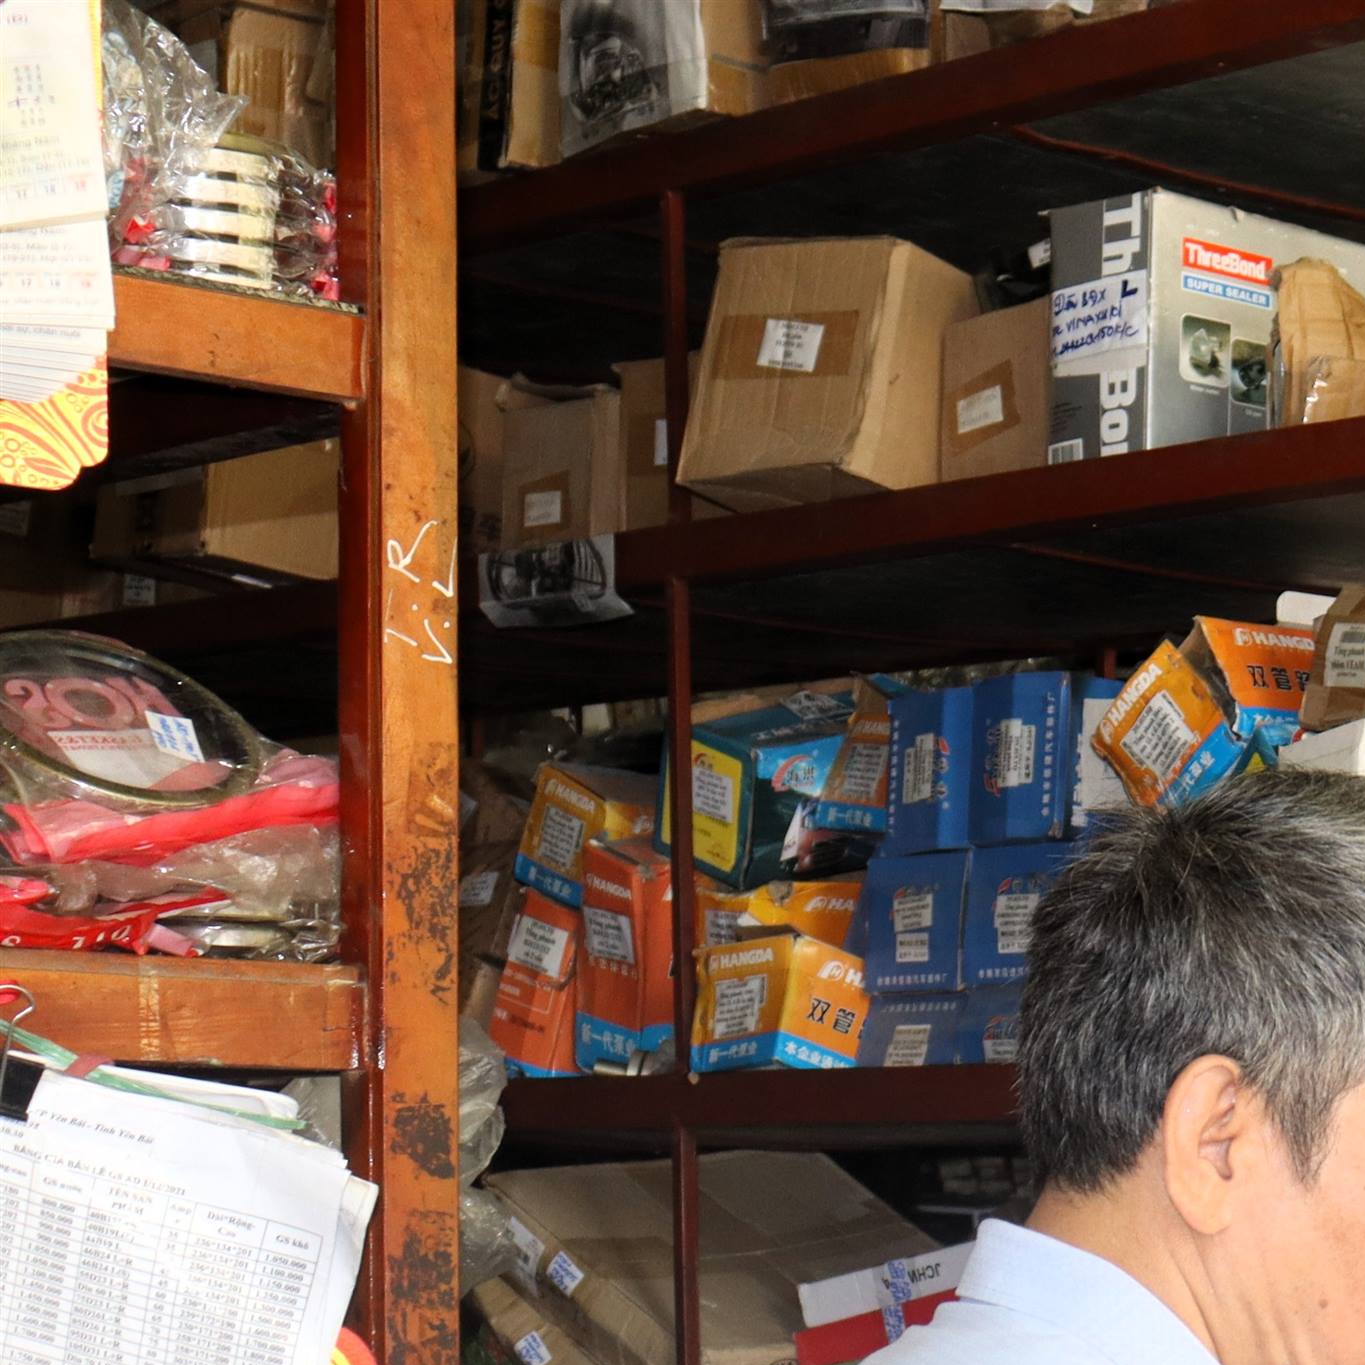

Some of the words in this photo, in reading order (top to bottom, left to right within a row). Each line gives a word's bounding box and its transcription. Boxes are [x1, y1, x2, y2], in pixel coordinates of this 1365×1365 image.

[1184, 242, 1267, 279] ThreeBond
[1187, 277, 1222, 294] SUPER
[1225, 285, 1267, 306] SEALER
[1254, 630, 1315, 651] HANGD
[1109, 663, 1164, 728] HANGDA
[554, 780, 596, 814] HANGDA
[593, 875, 633, 901] HANGDA
[718, 948, 775, 972] HANGDA
